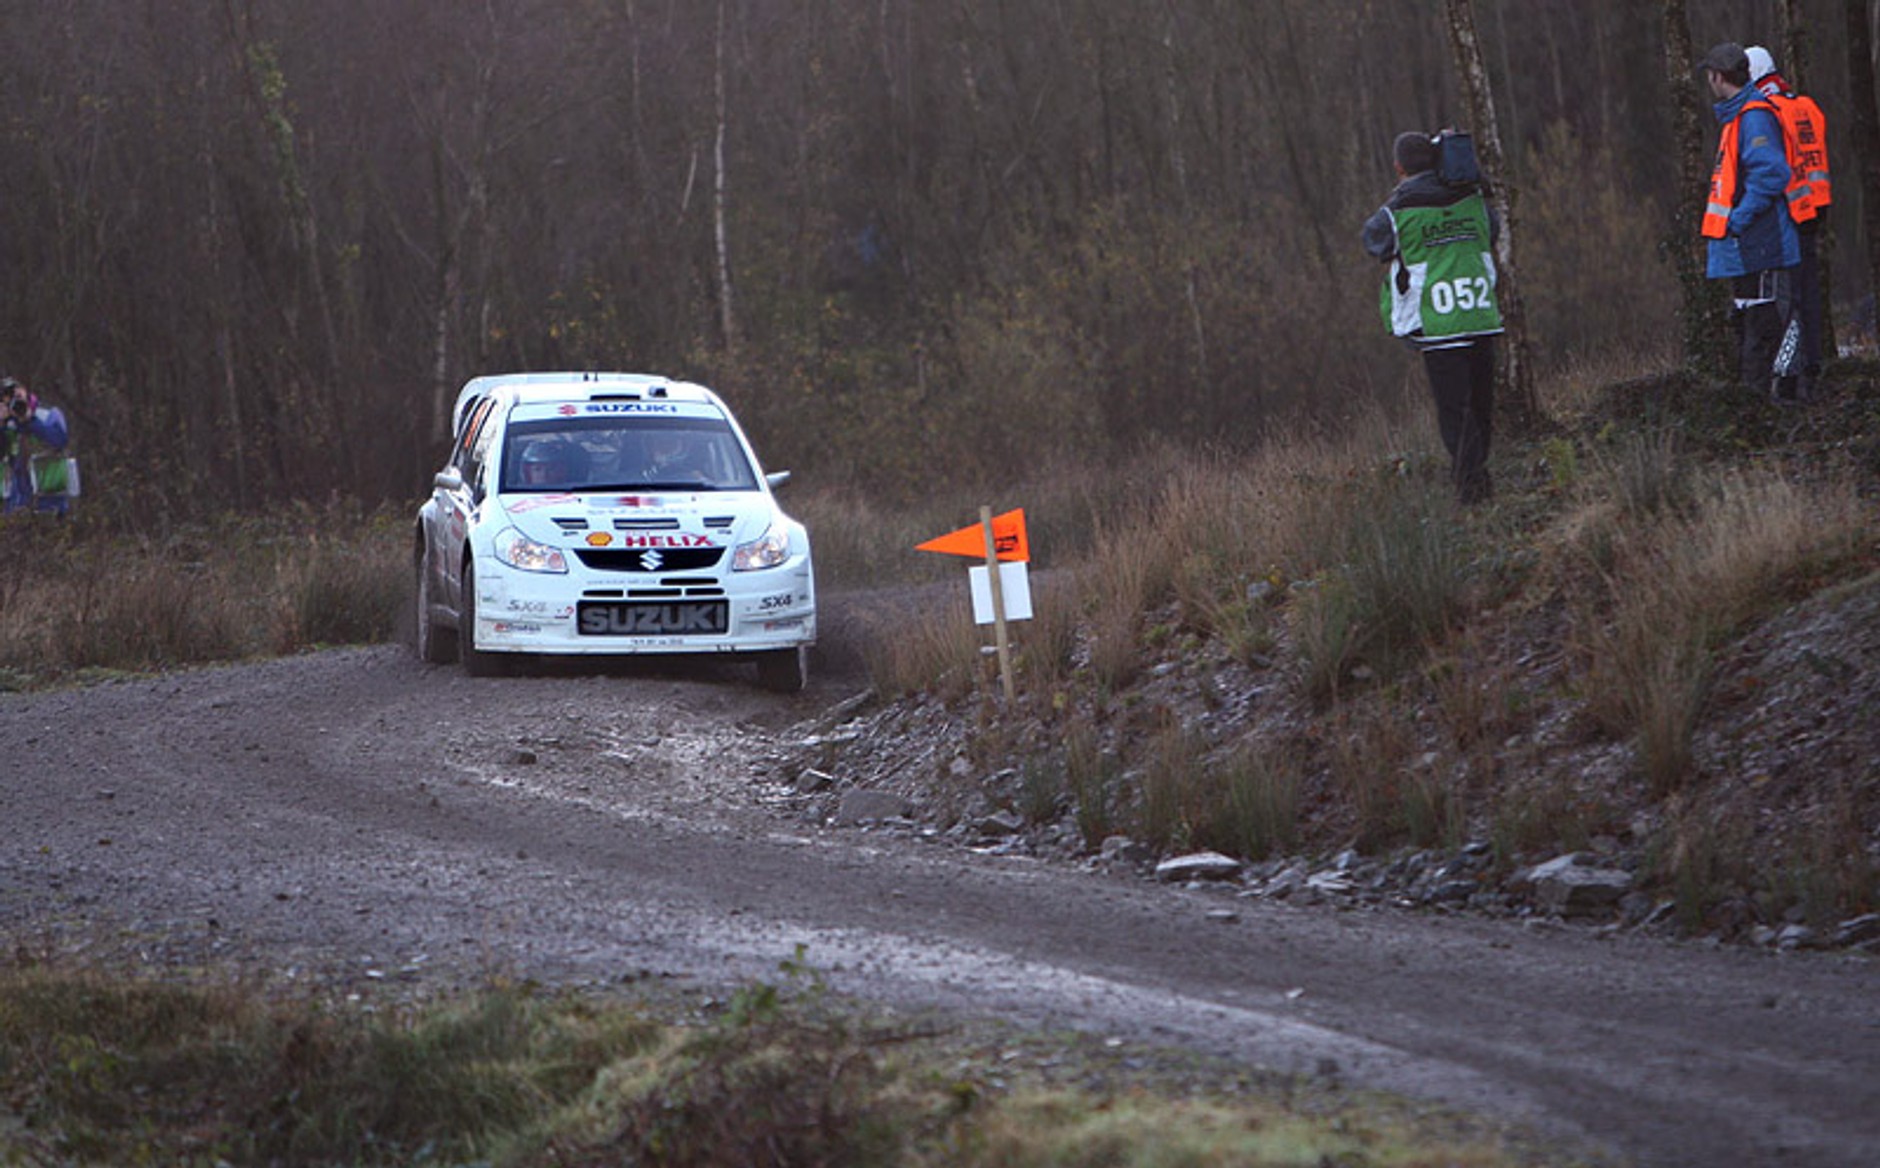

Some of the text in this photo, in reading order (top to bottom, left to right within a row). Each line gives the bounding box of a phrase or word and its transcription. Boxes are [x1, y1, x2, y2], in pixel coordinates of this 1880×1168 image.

[1431, 276, 1491, 314] 052
[585, 404, 678, 413] SUZUKI
[625, 535, 713, 547] HELIX
[759, 594, 793, 610] SX4
[582, 604, 726, 634] SUZUKI
